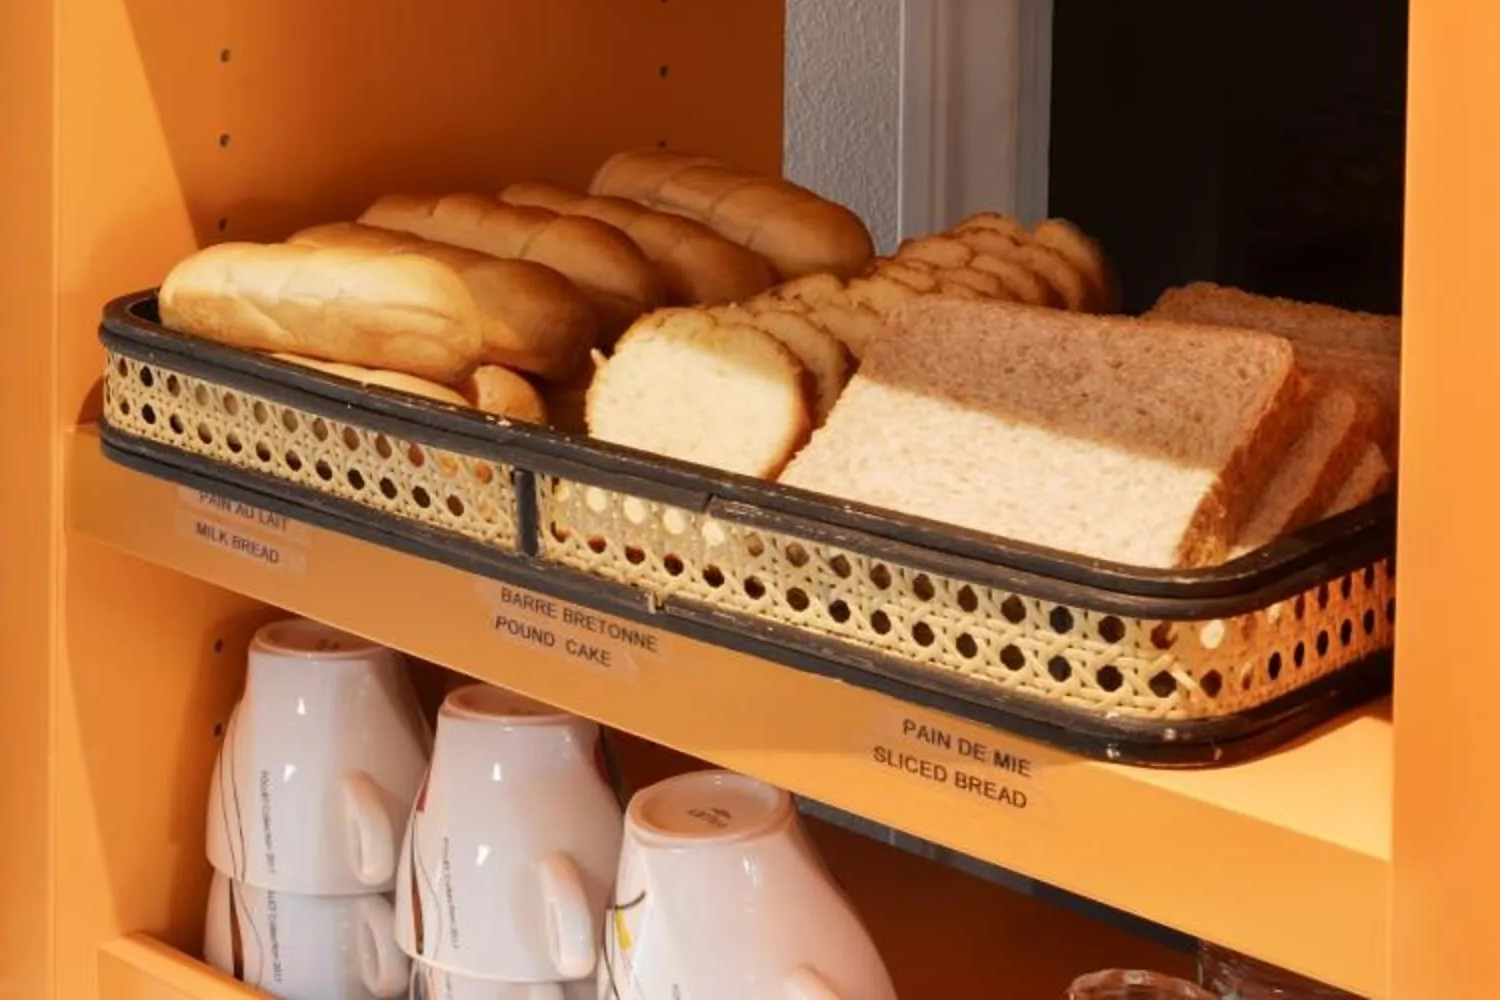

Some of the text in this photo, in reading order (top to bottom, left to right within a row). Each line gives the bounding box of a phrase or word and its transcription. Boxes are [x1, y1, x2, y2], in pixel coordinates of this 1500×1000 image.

[195, 522, 280, 564] MILK BREAD
[235, 502, 255, 520] AU
[258, 510, 289, 533] LAIT
[495, 615, 612, 668] POUND CAKE
[501, 587, 659, 653] BARRE BRETONNE
[902, 718, 1033, 778] PAIN DE MIE
[872, 746, 1028, 809] SLICED BREAD
